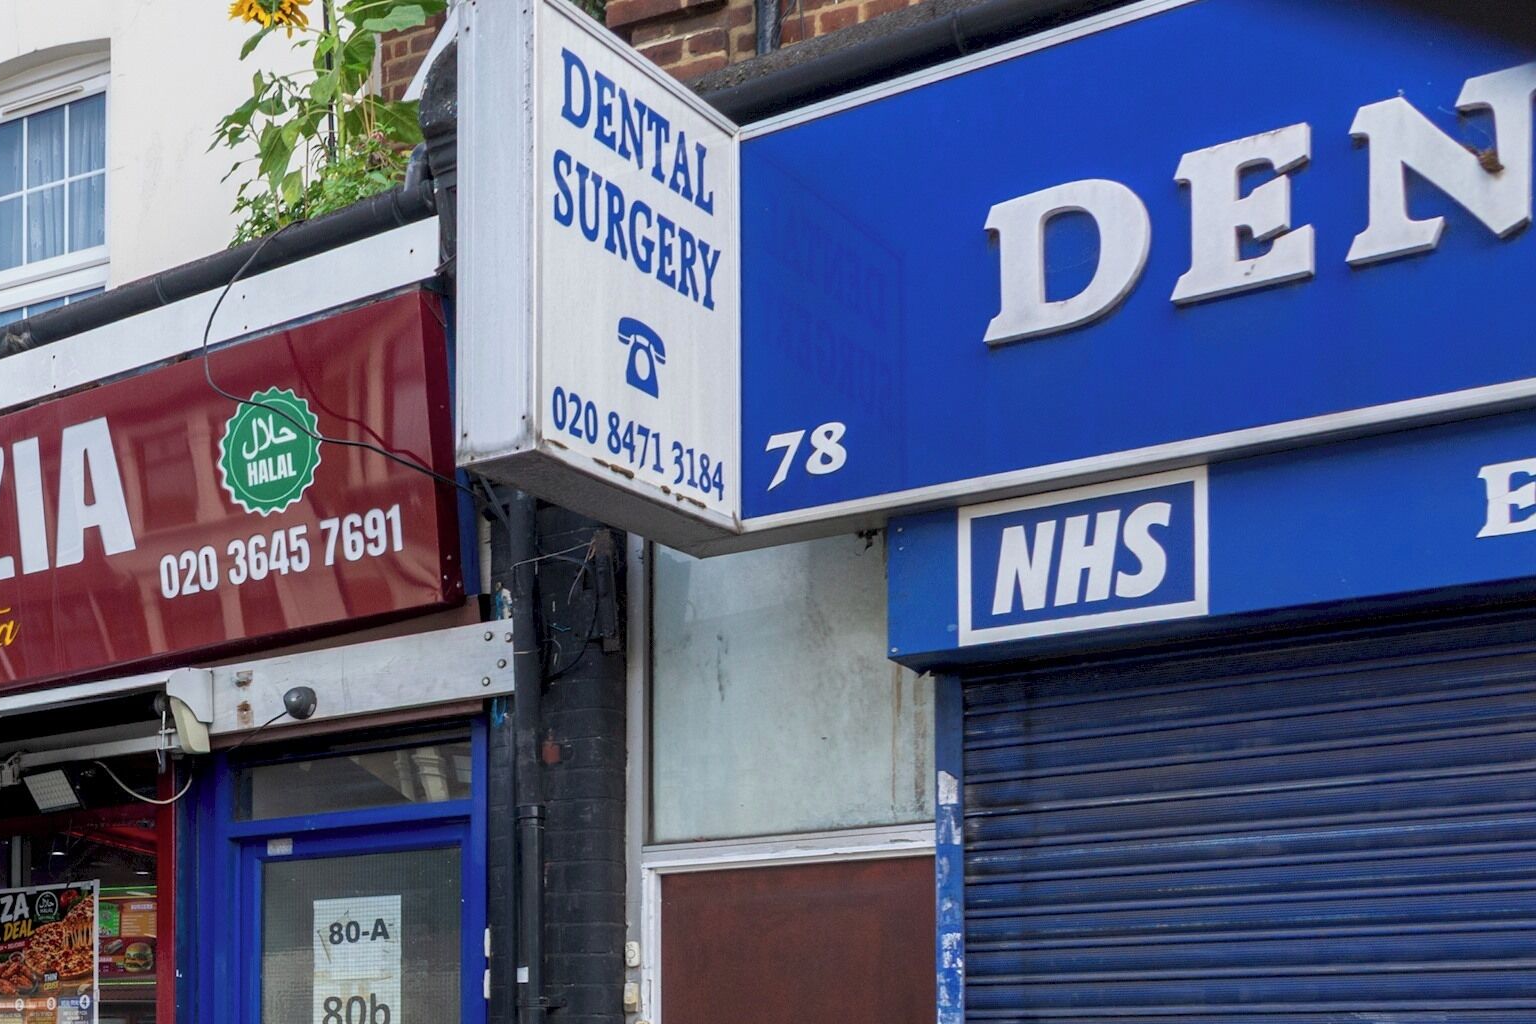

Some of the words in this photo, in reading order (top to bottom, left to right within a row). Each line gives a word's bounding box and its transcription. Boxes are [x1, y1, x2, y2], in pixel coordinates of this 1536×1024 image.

[560, 47, 715, 216] DENTAL
[552, 149, 722, 312] SURGERY
[241, 413, 297, 460] حلال
[247, 453, 297, 487] HALAL
[551, 386, 598, 445] 020
[607, 411, 665, 474] 8471
[672, 441, 725, 501] 3184
[764, 421, 848, 492] 78
[159, 545, 219, 599] 020
[226, 524, 311, 586] 3645
[319, 503, 404, 567] 7691
[991, 500, 1172, 616] NHS
[3, 918, 36, 942] DEAL
[328, 917, 390, 947] 80-A
